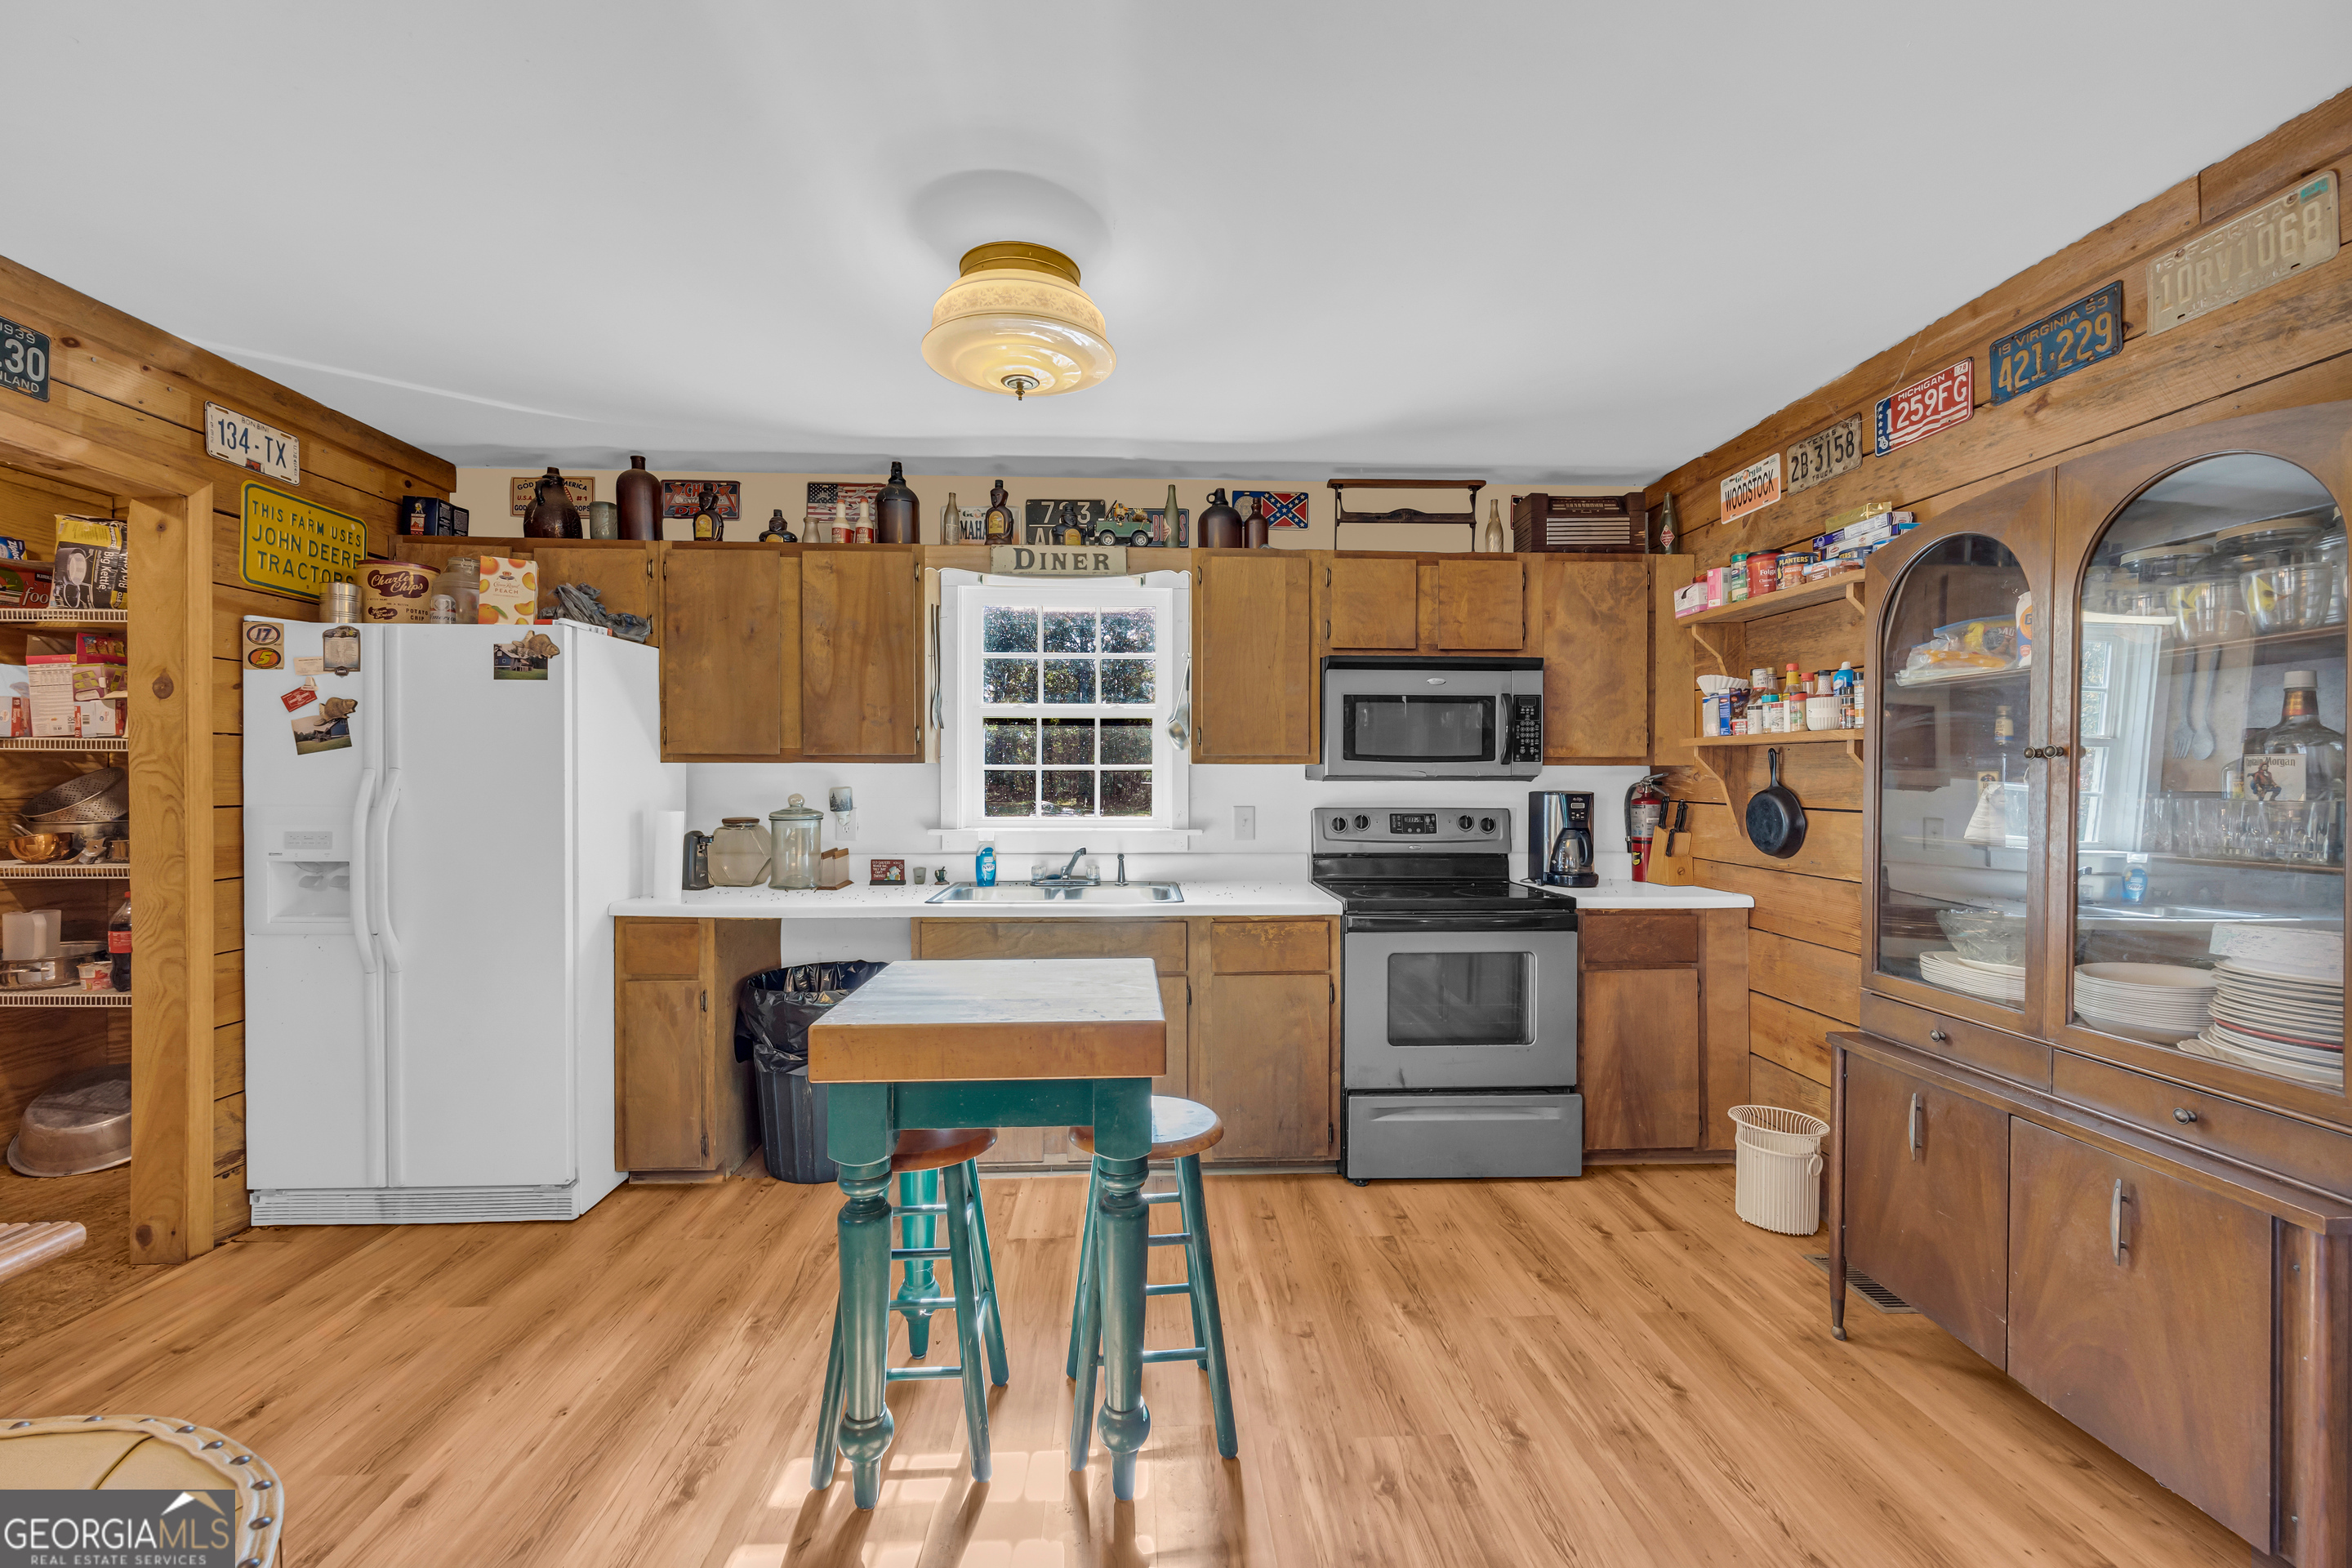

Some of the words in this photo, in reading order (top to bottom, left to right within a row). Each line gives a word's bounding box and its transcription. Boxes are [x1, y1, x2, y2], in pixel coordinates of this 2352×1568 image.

[2016, 310, 2080, 347] VIRGINIA
[2085, 295, 2109, 314] 53
[0, 338, 46, 382] 30
[1898, 373, 1945, 402] MICHIGAN
[218, 418, 287, 469] 134-TX
[1807, 428, 1838, 447] TEXAS
[1811, 468, 1833, 482] TRUCK
[517, 482, 534, 490] GOD
[564, 480, 588, 492] MERICA
[684, 483, 717, 497] CHP
[1725, 468, 1775, 513] WOODSTOCK
[673, 506, 729, 515] DRP
[962, 509, 987, 519] Geor
[1041, 501, 1091, 523] 73
[252, 500, 283, 523] THIS
[291, 513, 324, 537] FARM
[331, 526, 361, 547] USES
[1153, 514, 1186, 542] BIS
[252, 524, 301, 554] JOHN
[308, 539, 361, 570] DEERE
[100, 550, 114, 564] Big
[1013, 547, 1111, 571] DINER
[1780, 557, 1808, 565] PLANTERS
[99, 565, 112, 590] Kettle
[21, 586, 49, 606] foo
[390, 581, 423, 595] Chips
[254, 628, 272, 642] 17
[256, 651, 274, 665] 5
[2266, 756, 2296, 767] Morgan
